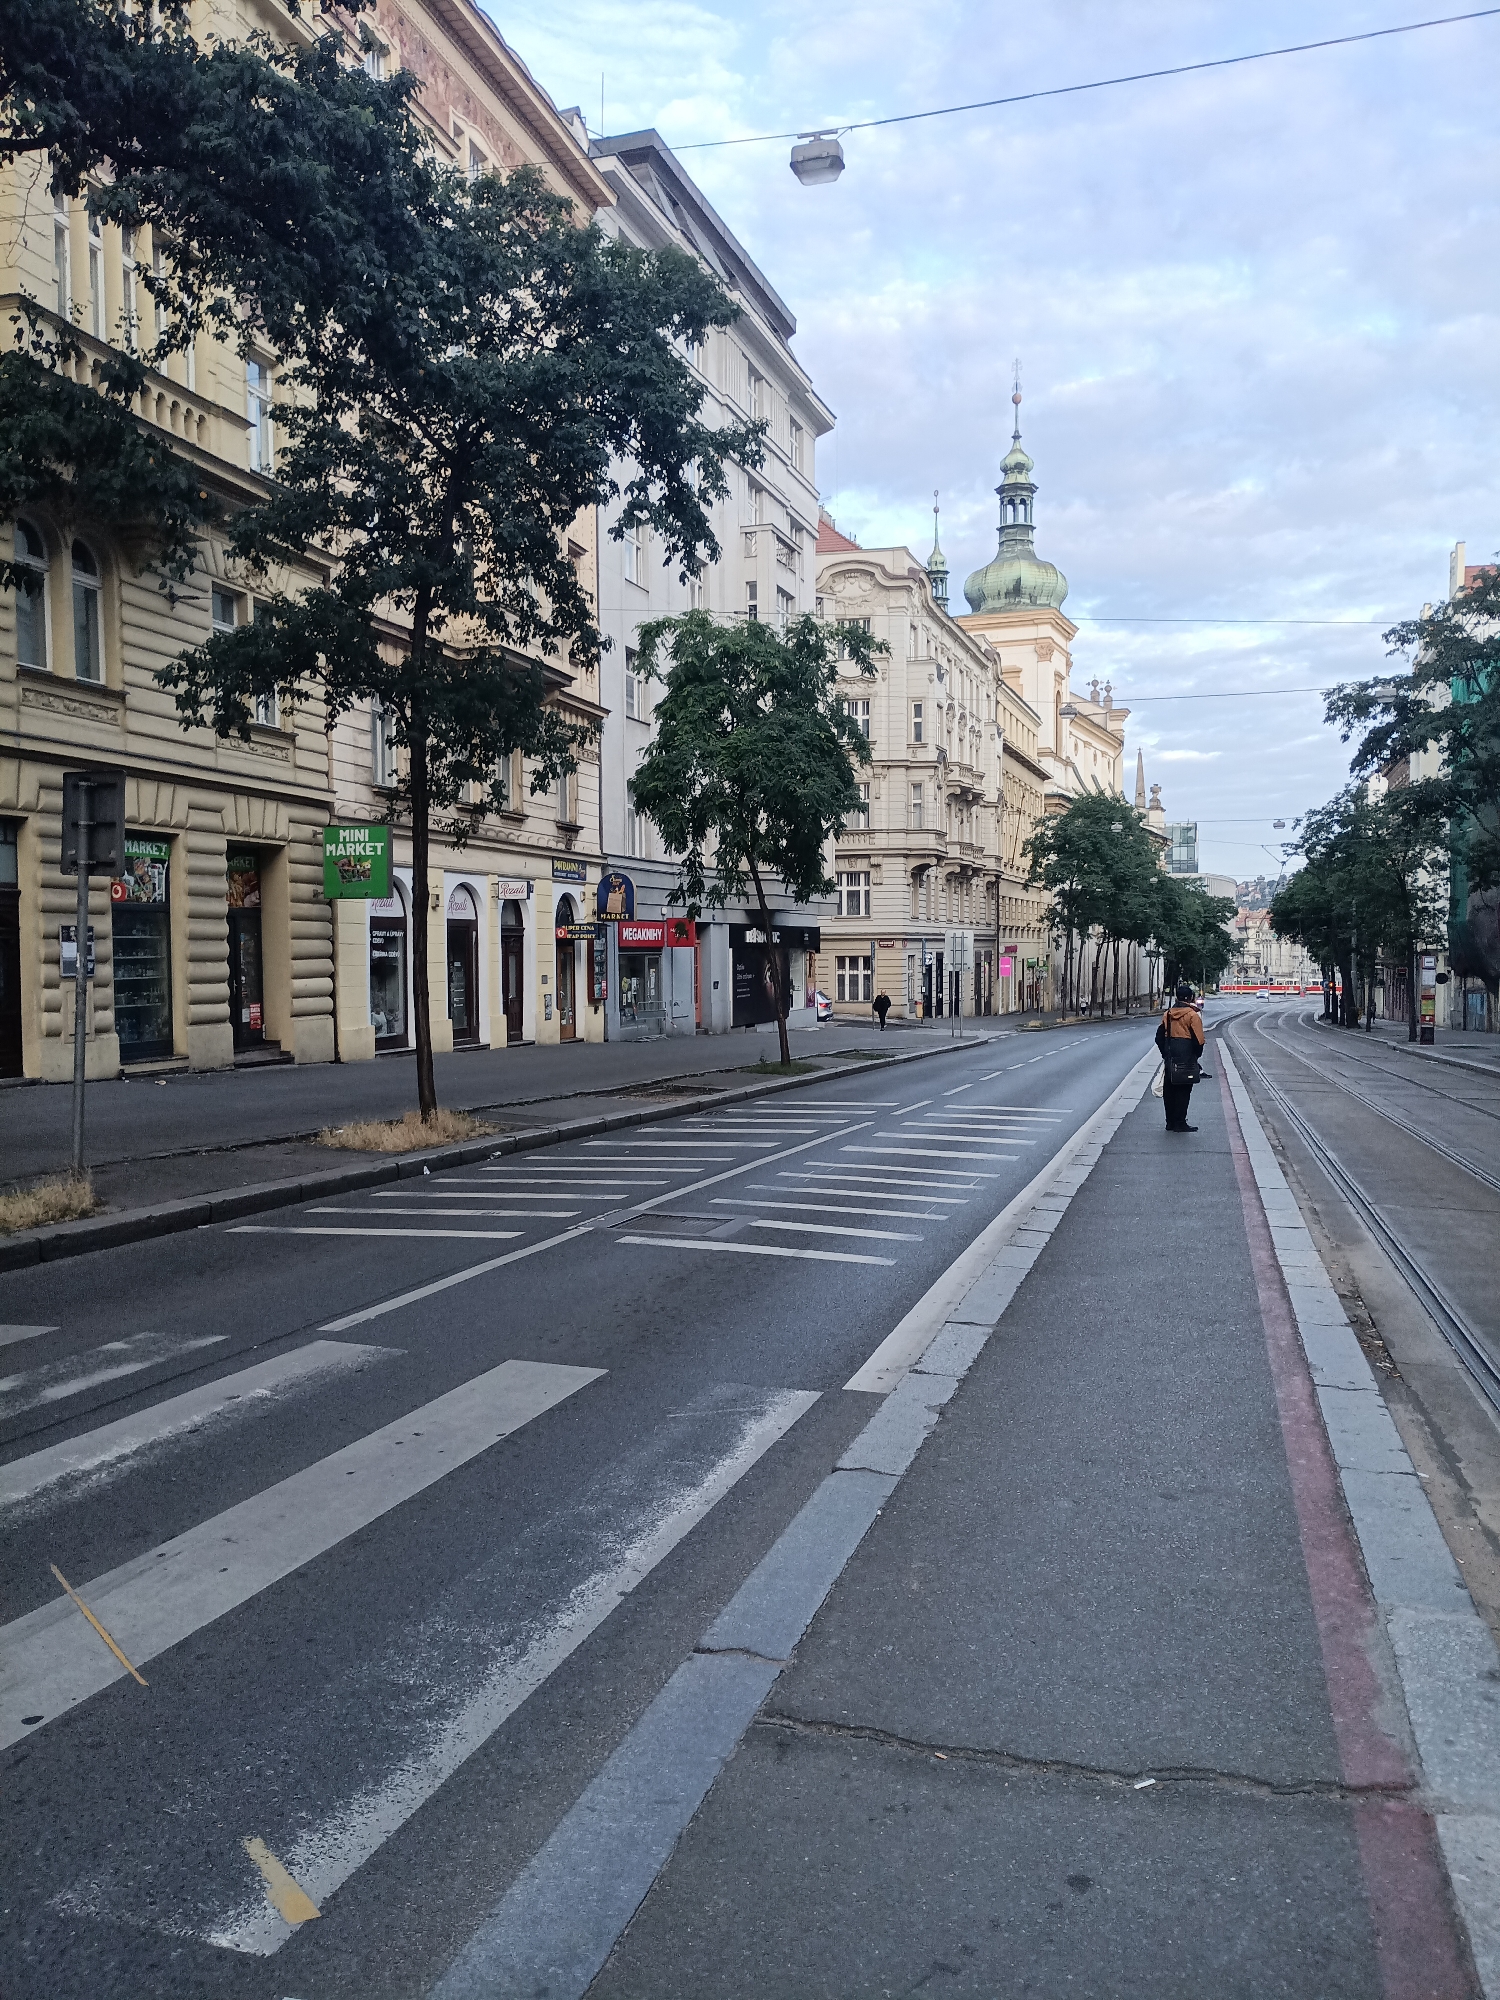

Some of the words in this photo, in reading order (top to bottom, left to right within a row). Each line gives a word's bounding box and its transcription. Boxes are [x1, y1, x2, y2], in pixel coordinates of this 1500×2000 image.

[339, 829, 369, 842] MINI
[124, 840, 168, 856] MARKET
[326, 843, 385, 856] MARKET
[227, 856, 255, 869] ARKET
[622, 927, 662, 941] MEGAKNIHY
